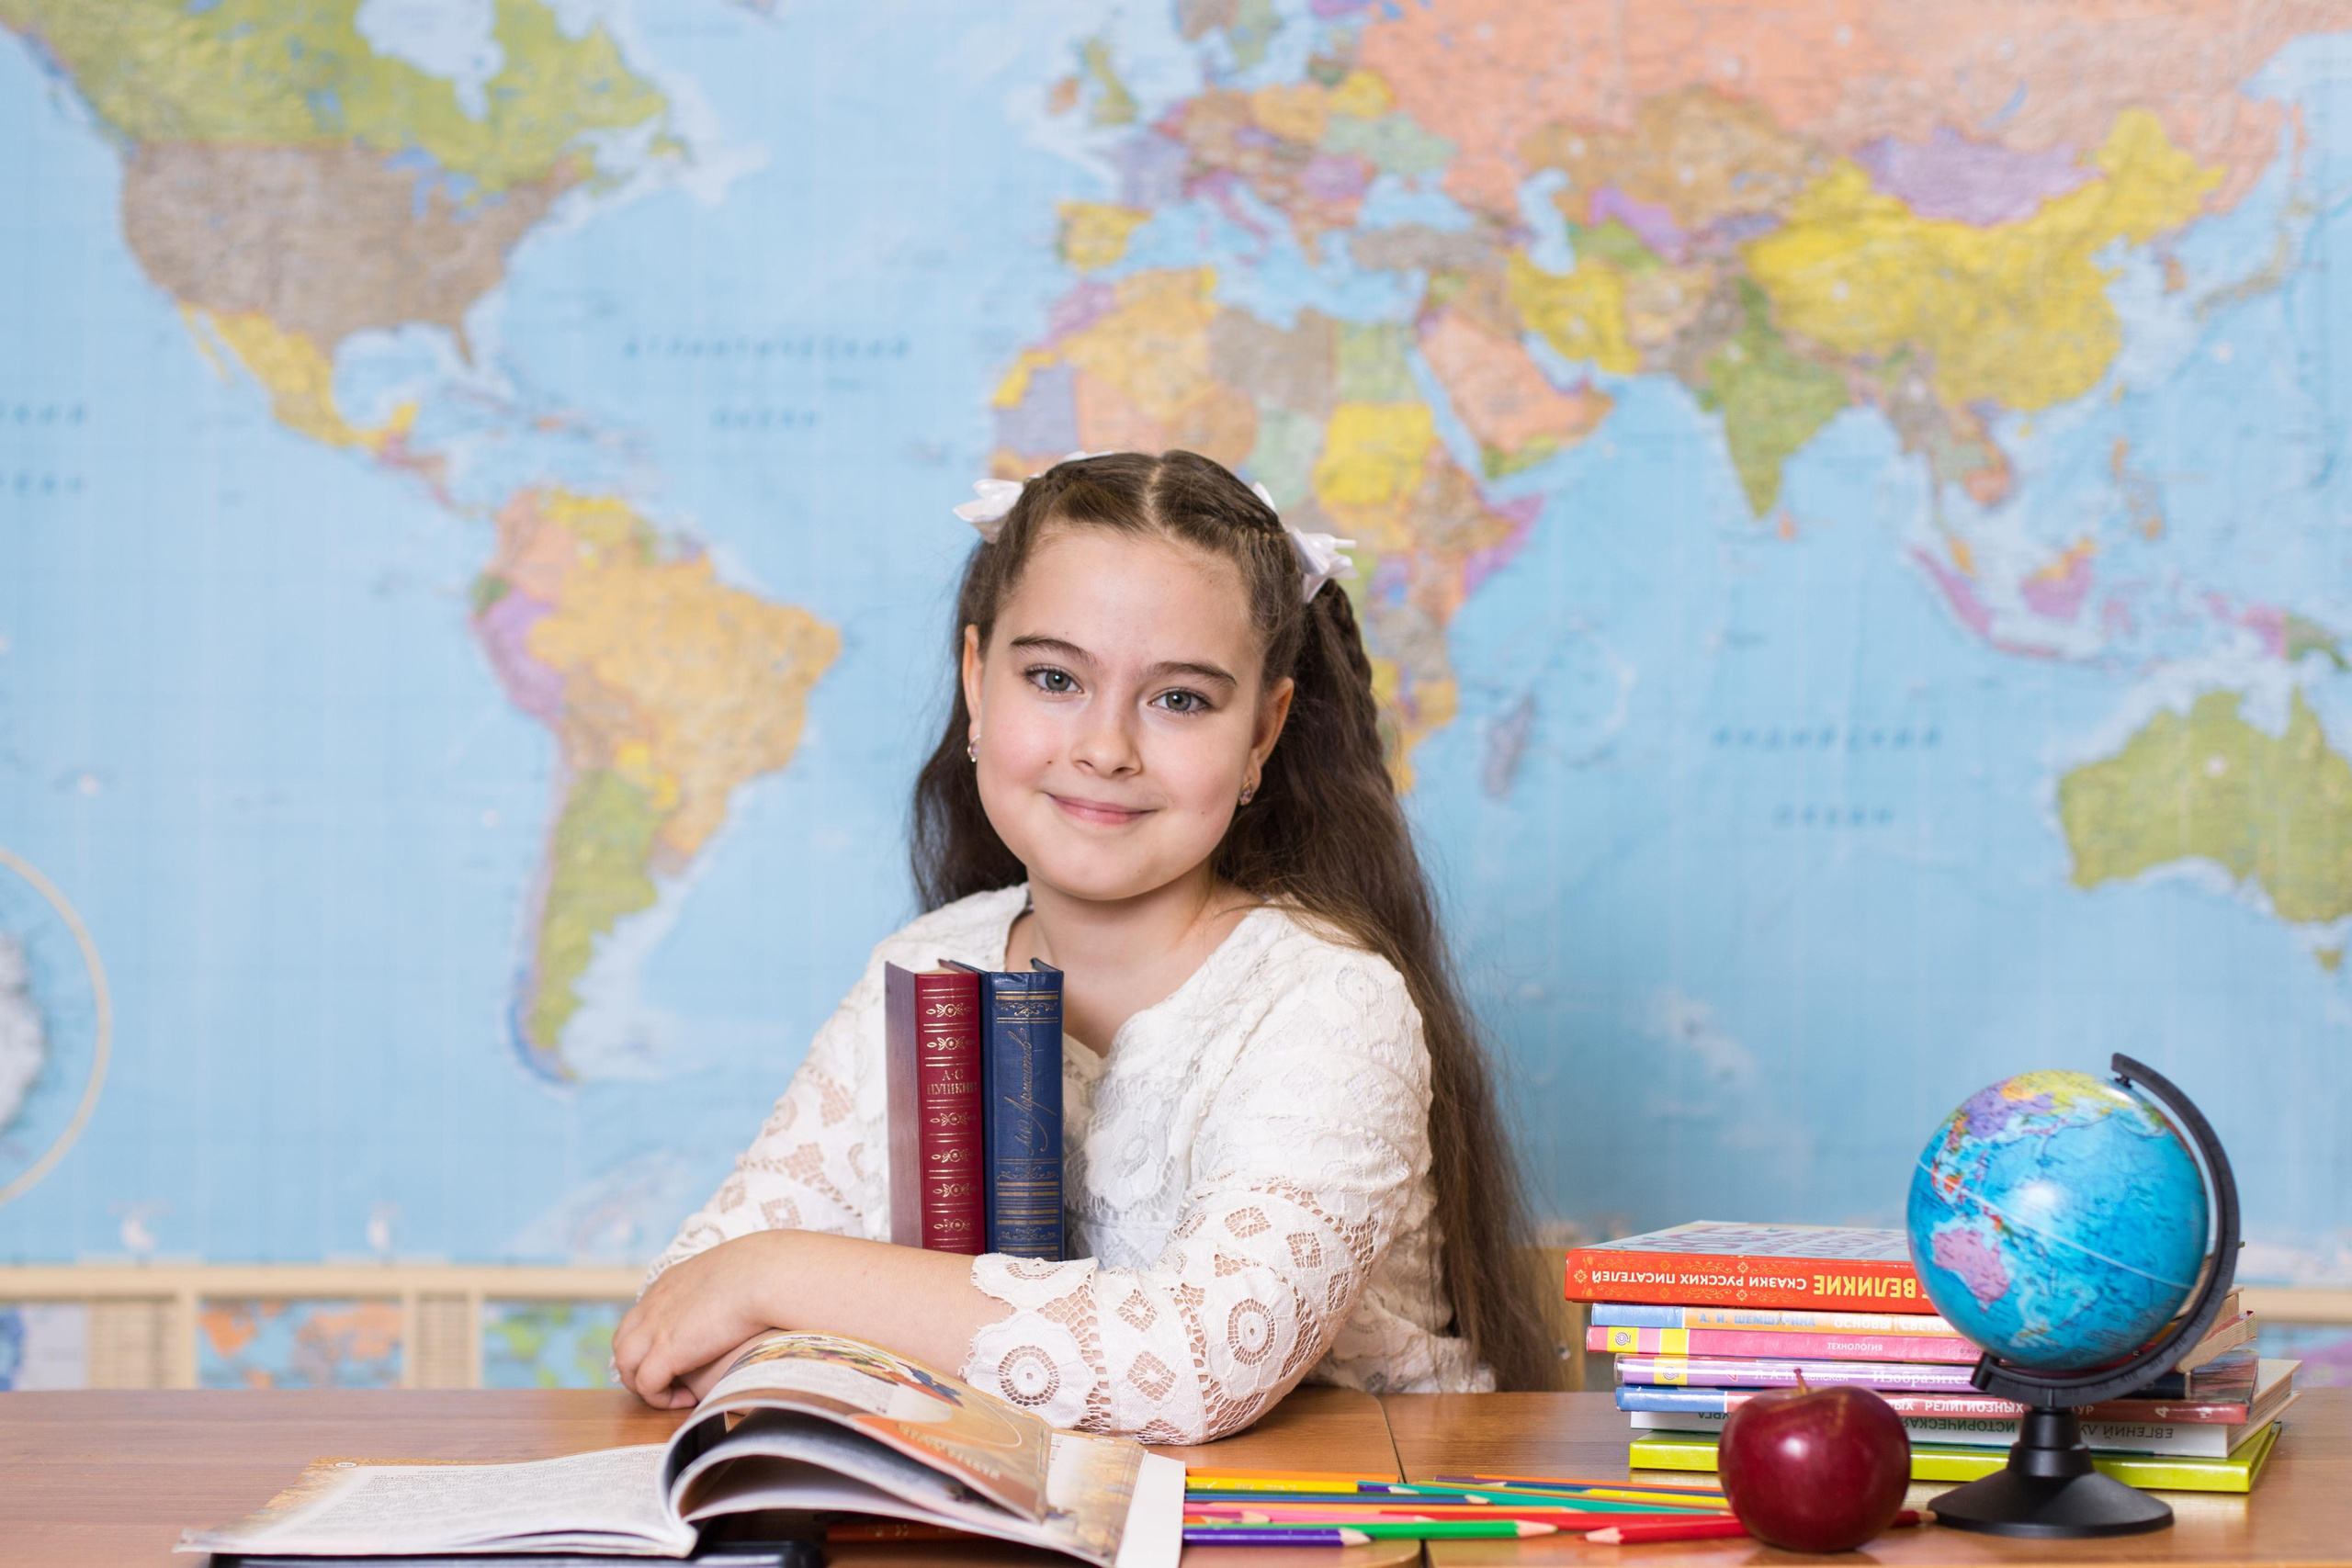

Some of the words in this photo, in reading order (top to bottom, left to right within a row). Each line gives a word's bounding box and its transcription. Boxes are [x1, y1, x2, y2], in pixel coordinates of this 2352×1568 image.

[1591, 1270, 1676, 1284] ПИСАТЕЛЕЙ
[1679, 1273, 1745, 1287] РУССКИХ
[1748, 1276, 1807, 1291] СКАЗКИ
[1813, 1274, 1917, 1299] ВЕЛИКИЕ
[1834, 1316, 1893, 1331] ОСНОВЫ
[1826, 1342, 1883, 1352] ТЕХНОЛОГИЯ
[1924, 1400, 2025, 1414] РЕЛИГИОЗНЫХ
[2103, 1426, 2174, 1439] ЕВГЕНИЙ
